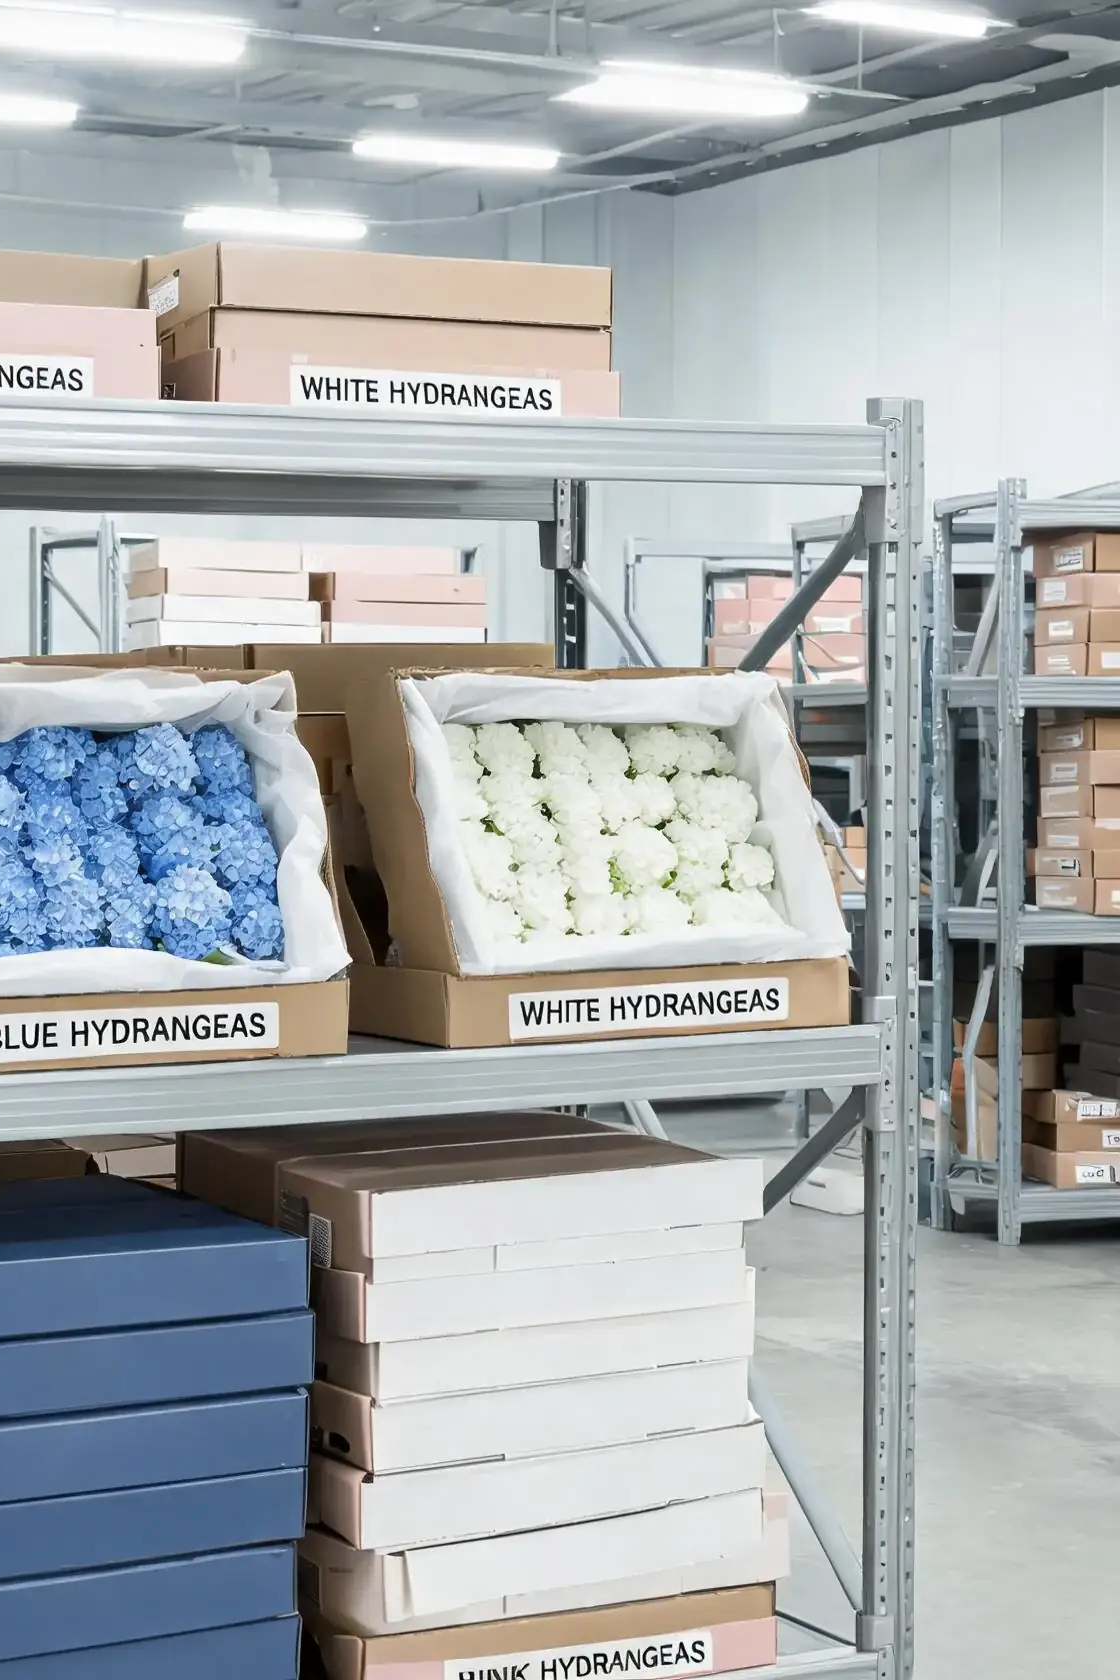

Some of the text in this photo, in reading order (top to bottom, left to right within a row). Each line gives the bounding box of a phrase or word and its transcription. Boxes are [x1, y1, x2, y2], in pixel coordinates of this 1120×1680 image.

[300, 374, 553, 411] WHITE HYDRANGEAS
[519, 987, 780, 1027] WHITE HYDRANGEAS
[71, 1012, 266, 1047] HYDRANGEAS
[541, 1640, 705, 1680] HYDRANGEAS
